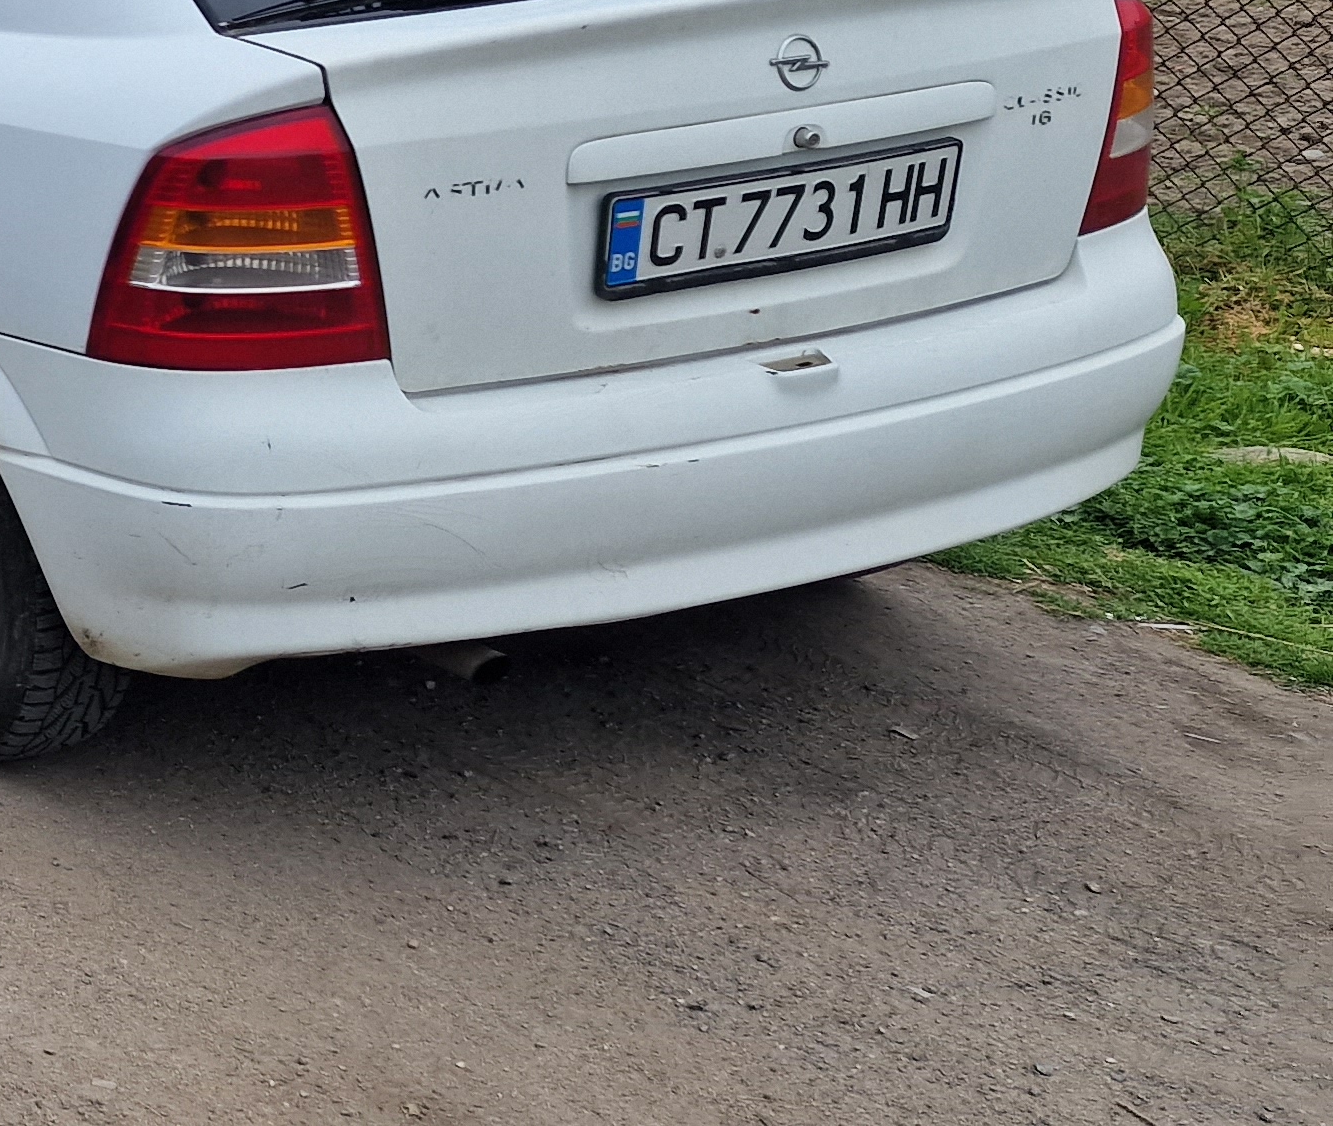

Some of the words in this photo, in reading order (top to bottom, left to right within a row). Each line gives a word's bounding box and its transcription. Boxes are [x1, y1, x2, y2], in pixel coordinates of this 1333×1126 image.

[650, 196, 727, 267] CT
[733, 174, 866, 254] 7731
[877, 157, 948, 229] HH
[611, 252, 635, 272] BG
